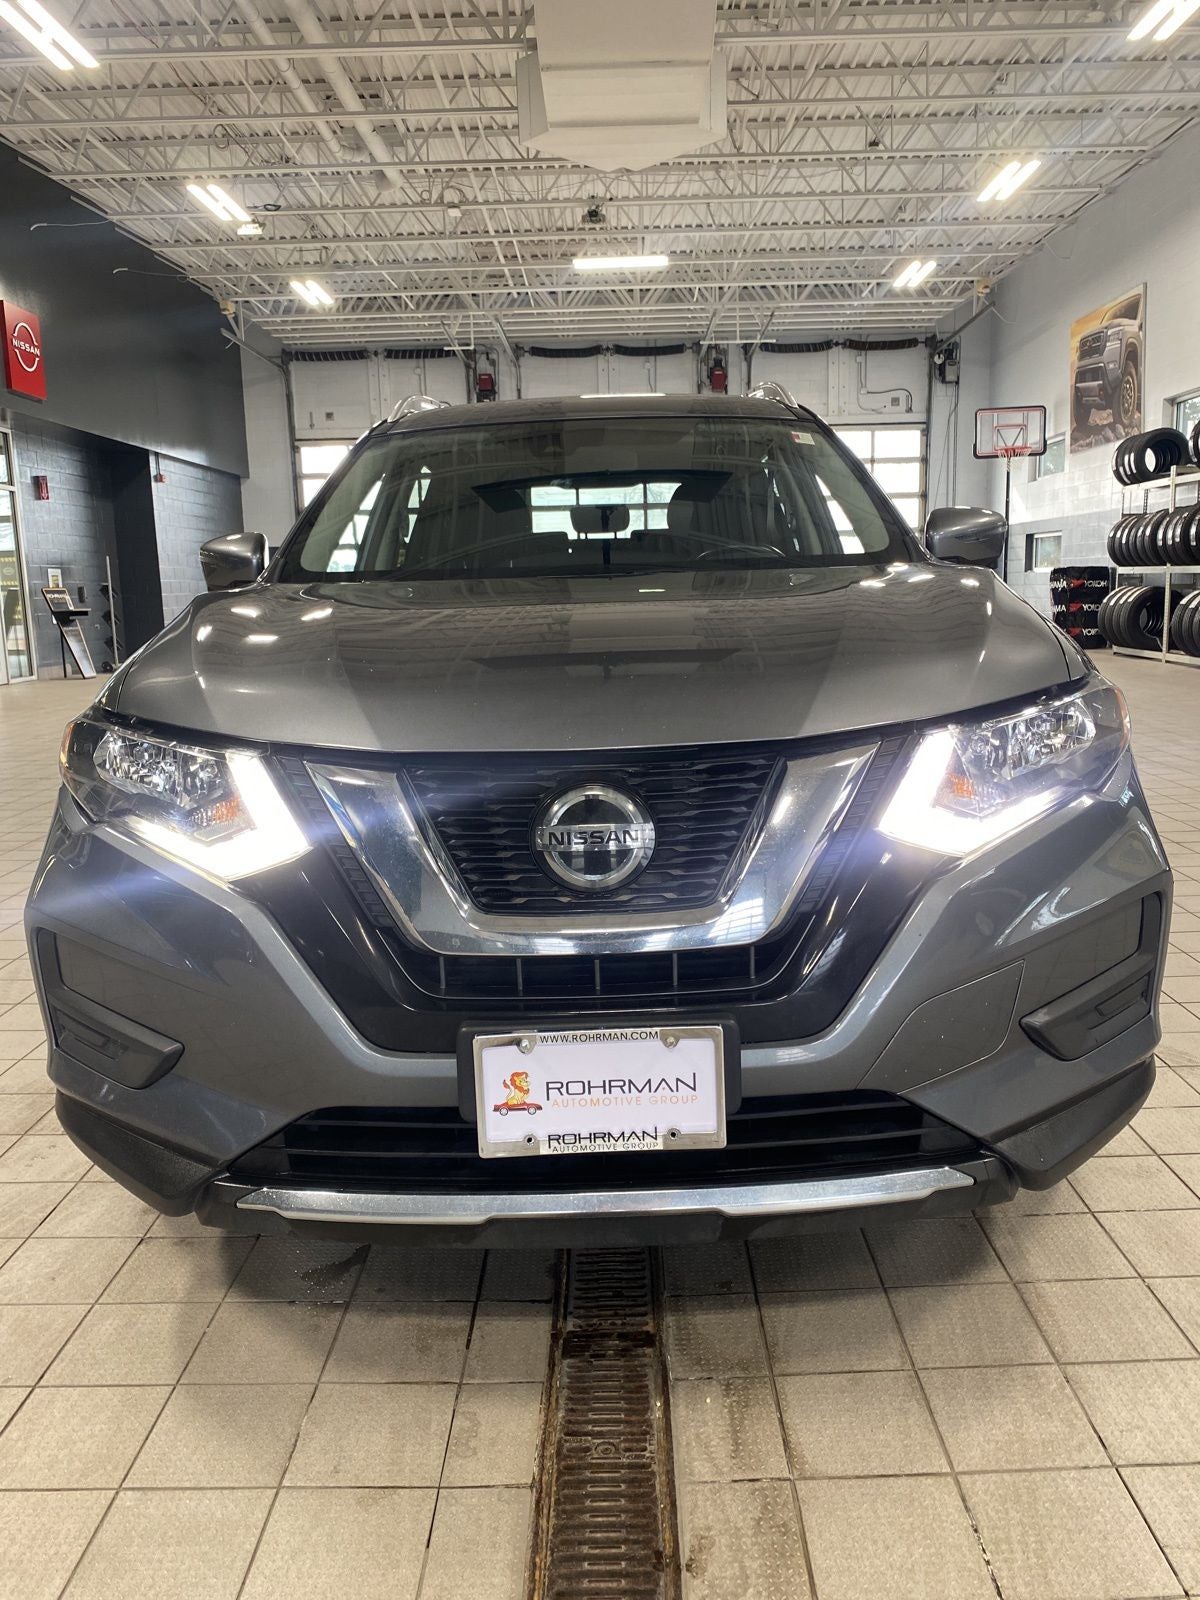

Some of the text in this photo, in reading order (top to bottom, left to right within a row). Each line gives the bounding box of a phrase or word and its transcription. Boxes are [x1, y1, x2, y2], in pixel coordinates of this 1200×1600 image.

[12, 337, 40, 356] NISSAN
[548, 829, 639, 846] NISSAN
[539, 1030, 659, 1044] WWW.ROHRMAN.COM
[546, 1072, 696, 1102] ROHRMAN
[552, 1094, 698, 1108] AUTOMOTIVE GROUP
[547, 1126, 658, 1149] ROHRMAN
[552, 1141, 659, 1153] AUTOMOTIVE GROUP
